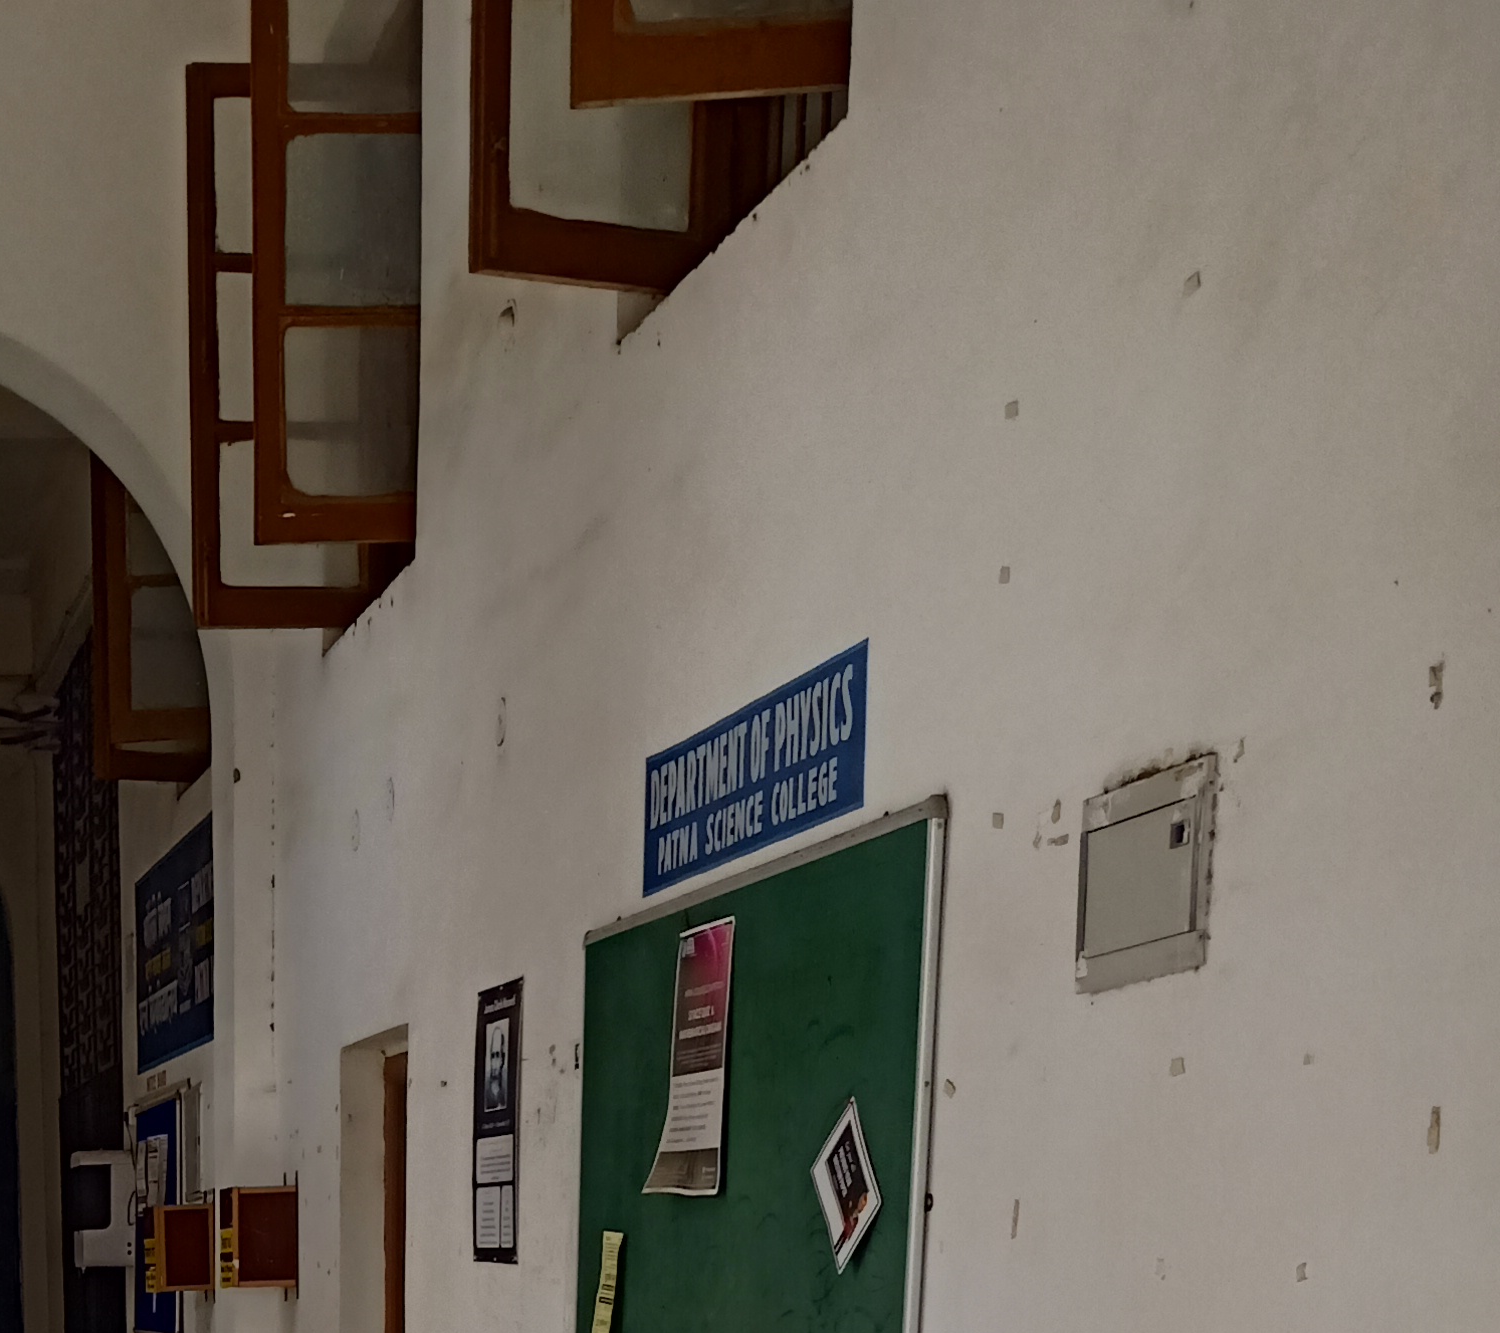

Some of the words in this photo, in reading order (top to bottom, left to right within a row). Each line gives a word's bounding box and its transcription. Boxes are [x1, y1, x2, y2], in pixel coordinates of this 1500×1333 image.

[650, 721, 748, 830] DEPARTMENT
[750, 709, 771, 783] OF
[774, 664, 854, 772] PHYSICS
[657, 821, 698, 875] PATNA
[705, 790, 764, 855] SCIENCE
[771, 757, 838, 826] COLLEGE
